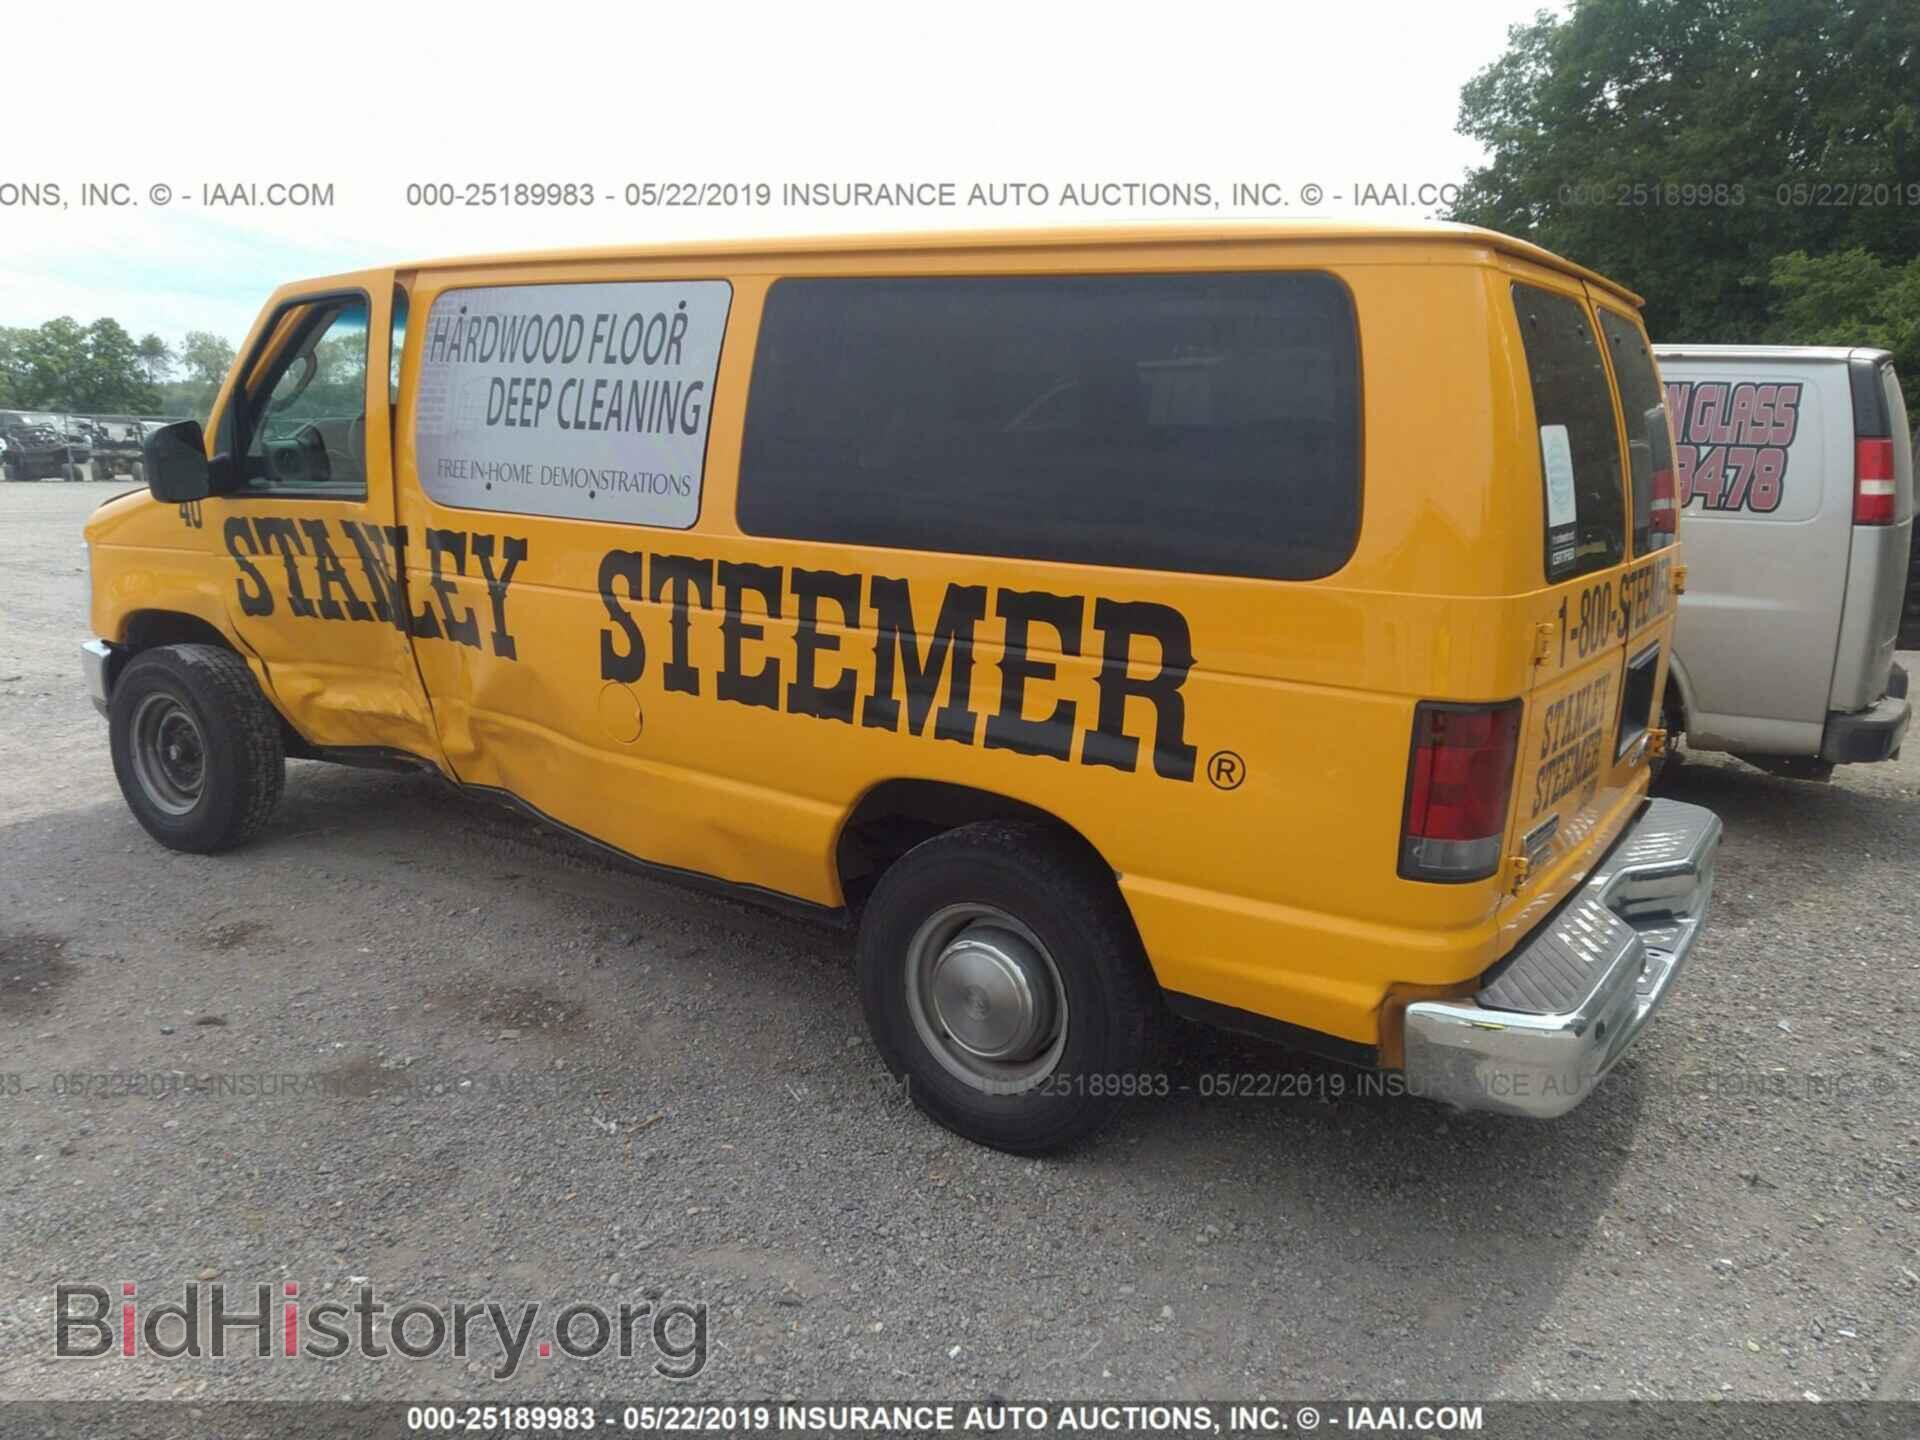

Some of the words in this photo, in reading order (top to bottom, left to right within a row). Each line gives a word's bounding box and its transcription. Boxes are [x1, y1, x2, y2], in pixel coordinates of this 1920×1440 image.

[430, 314, 584, 363] HARDWOOD
[587, 312, 689, 365] FLOOR
[485, 376, 552, 428] DEEP
[556, 377, 704, 436] CLEANING
[1688, 381, 1803, 447] GLASS
[436, 457, 468, 480] FREE
[469, 459, 533, 485] IN-HOME
[539, 464, 691, 497] DEMONSTRATIONS
[223, 516, 528, 661] STANLEY
[599, 548, 1198, 784] STEEMER
[1541, 672, 1612, 761] STANLEY
